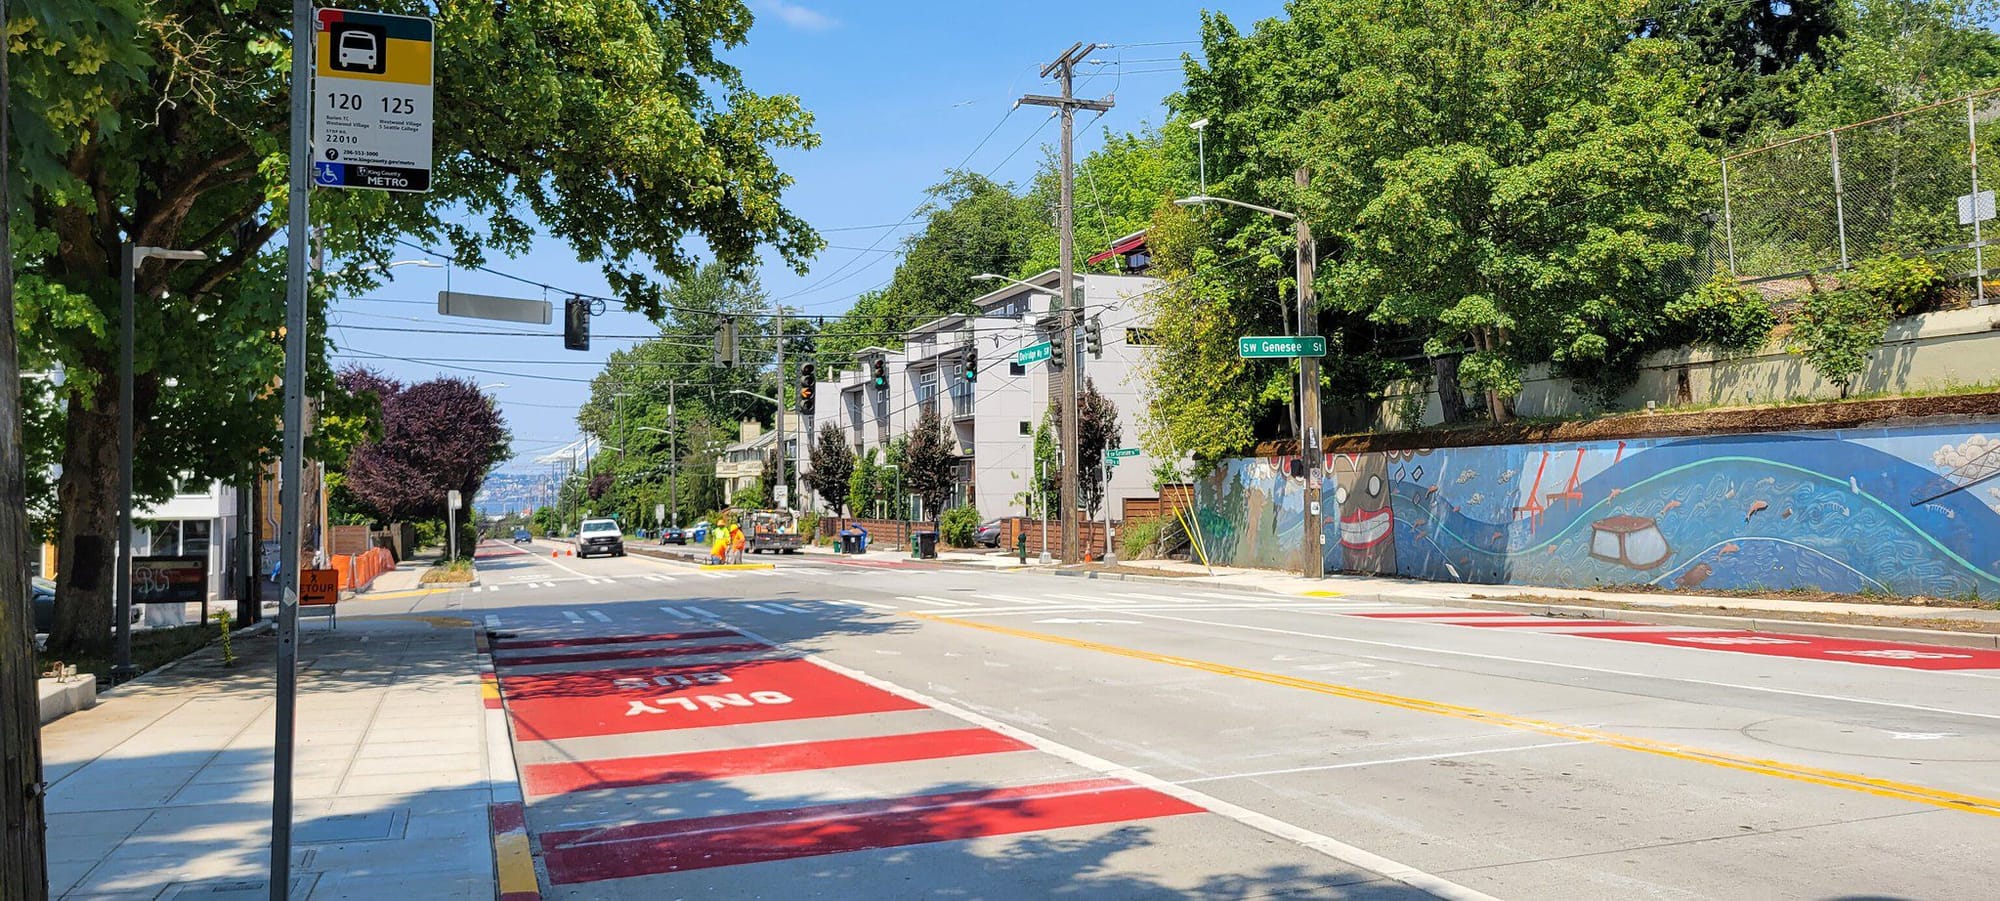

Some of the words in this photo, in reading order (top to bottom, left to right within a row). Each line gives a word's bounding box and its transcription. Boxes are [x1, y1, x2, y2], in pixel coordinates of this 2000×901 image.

[328, 92, 362, 110] 120
[381, 96, 414, 115] 125
[405, 120, 422, 128] Village
[326, 134, 358, 144] 22010
[368, 168, 381, 176] King
[381, 170, 401, 178] County
[367, 177, 408, 187] METRO
[1243, 343, 1257, 353] SW
[1261, 341, 1303, 353] Genesee
[1313, 342, 1323, 352] St
[300, 583, 334, 593] ETOUR
[613, 671, 734, 690] BUS
[625, 690, 794, 717] ONLY
